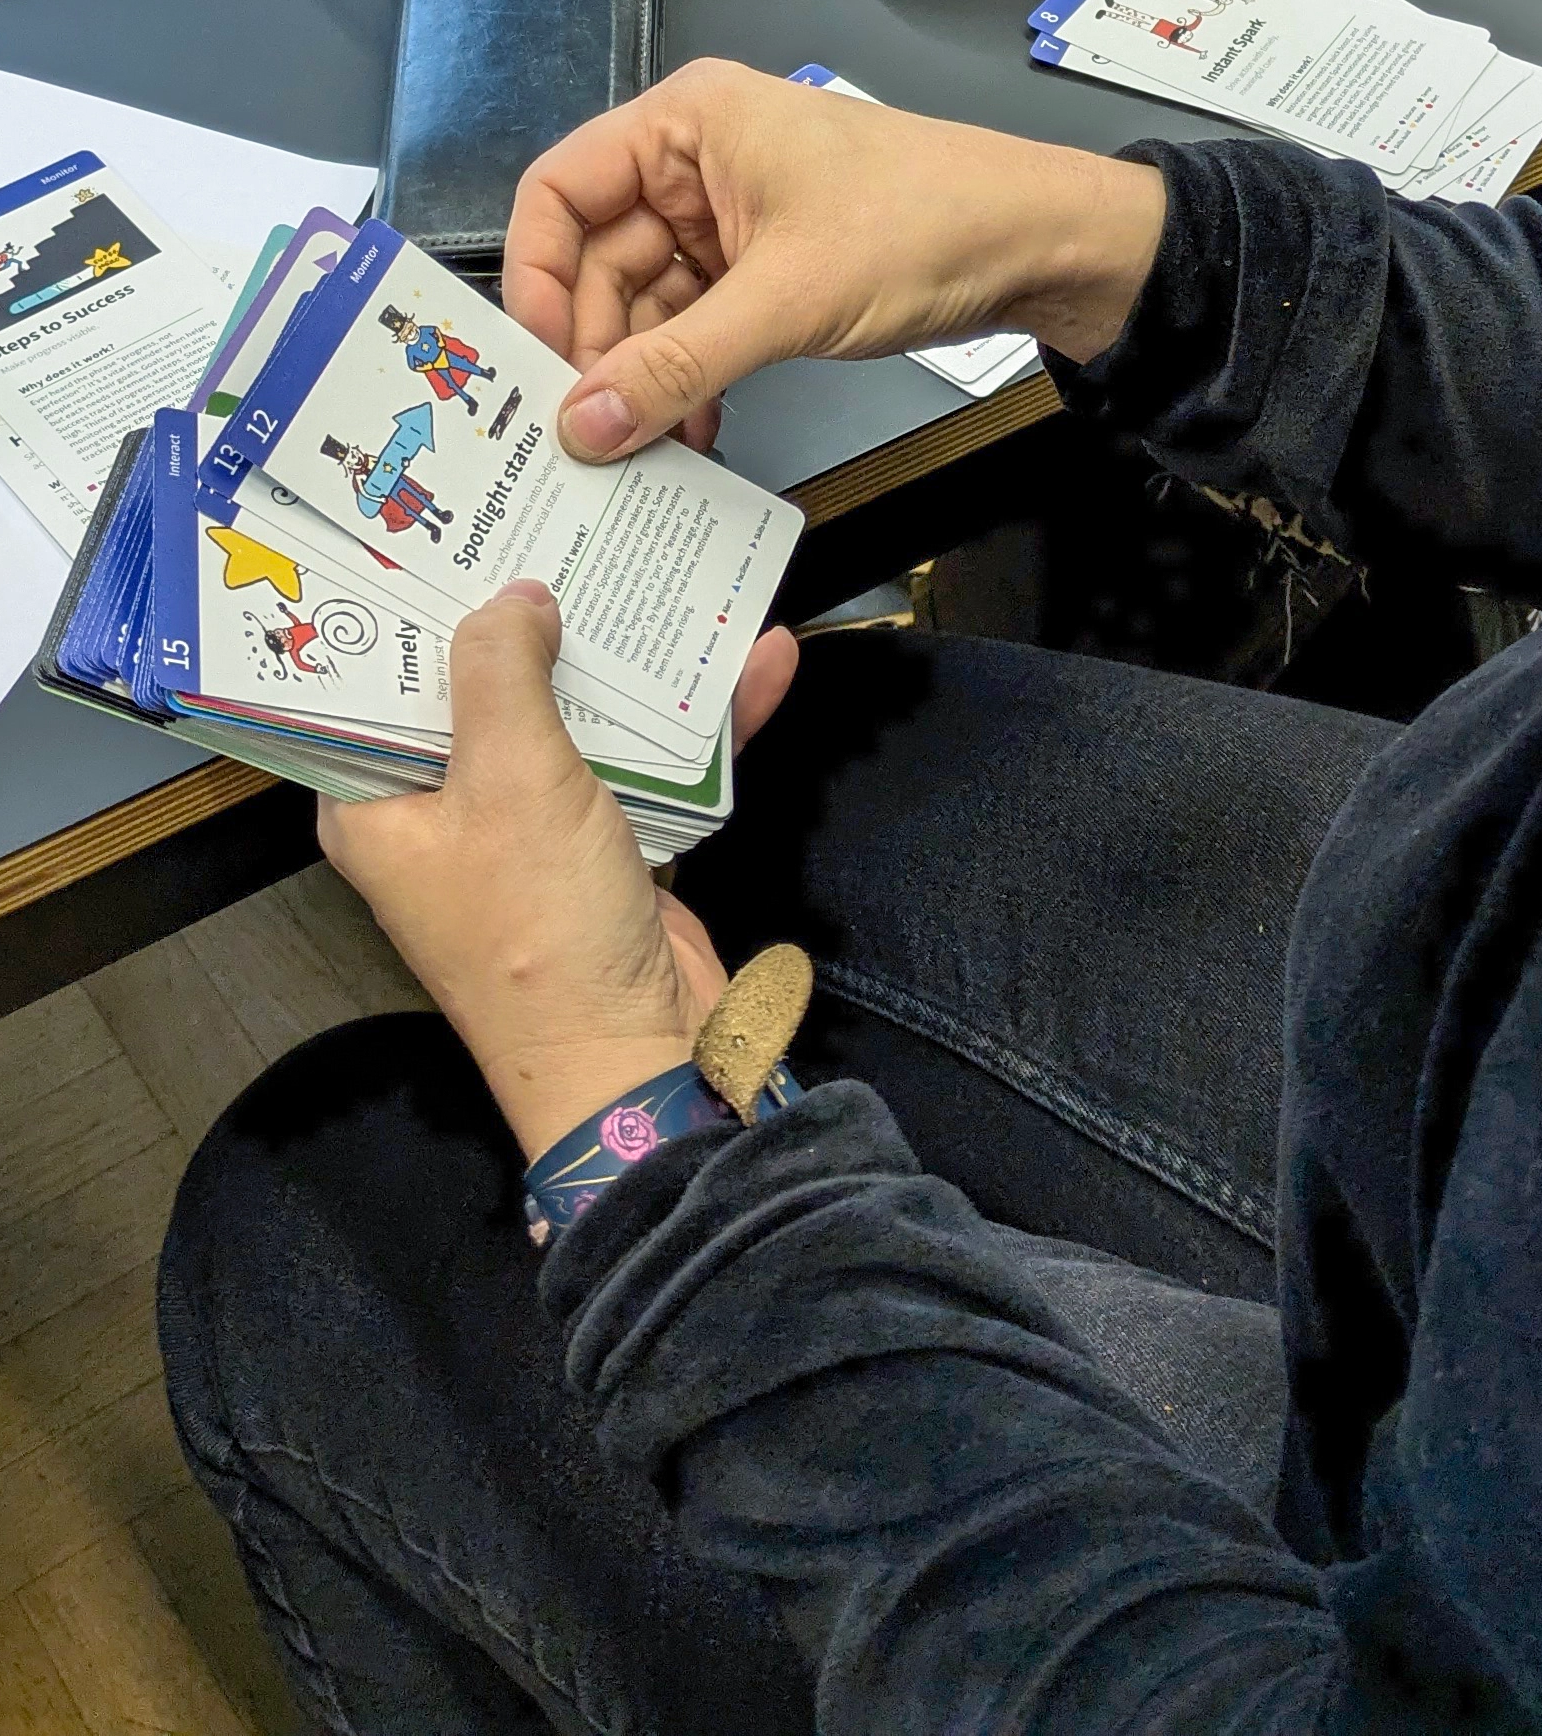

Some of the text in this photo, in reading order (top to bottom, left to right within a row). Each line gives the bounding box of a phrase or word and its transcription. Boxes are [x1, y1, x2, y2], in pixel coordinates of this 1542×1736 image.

[1040, 11, 1059, 23] 8
[1040, 40, 1059, 50] 7
[1200, 17, 1267, 83] Instant Spark
[1265, 92, 1284, 107] Why
[1277, 79, 1295, 94] does
[1295, 55, 1314, 74] work?
[40, 163, 79, 186] Monitor
[348, 243, 380, 285] Monitor
[39, 321, 62, 334] to
[61, 284, 135, 324] Success
[0, 324, 100, 374] Make progress visible.
[17, 342, 116, 396] Why does it work?
[246, 409, 279, 444] 12
[169, 434, 181, 478] Interact
[213, 443, 245, 476] 13
[452, 422, 543, 570] Spotlight status
[482, 449, 564, 584] Turn achievements into badges
[523, 481, 566, 553] and social status.
[549, 523, 590, 591] does it work?
[163, 638, 191, 671] 15
[395, 619, 421, 696] Timely
